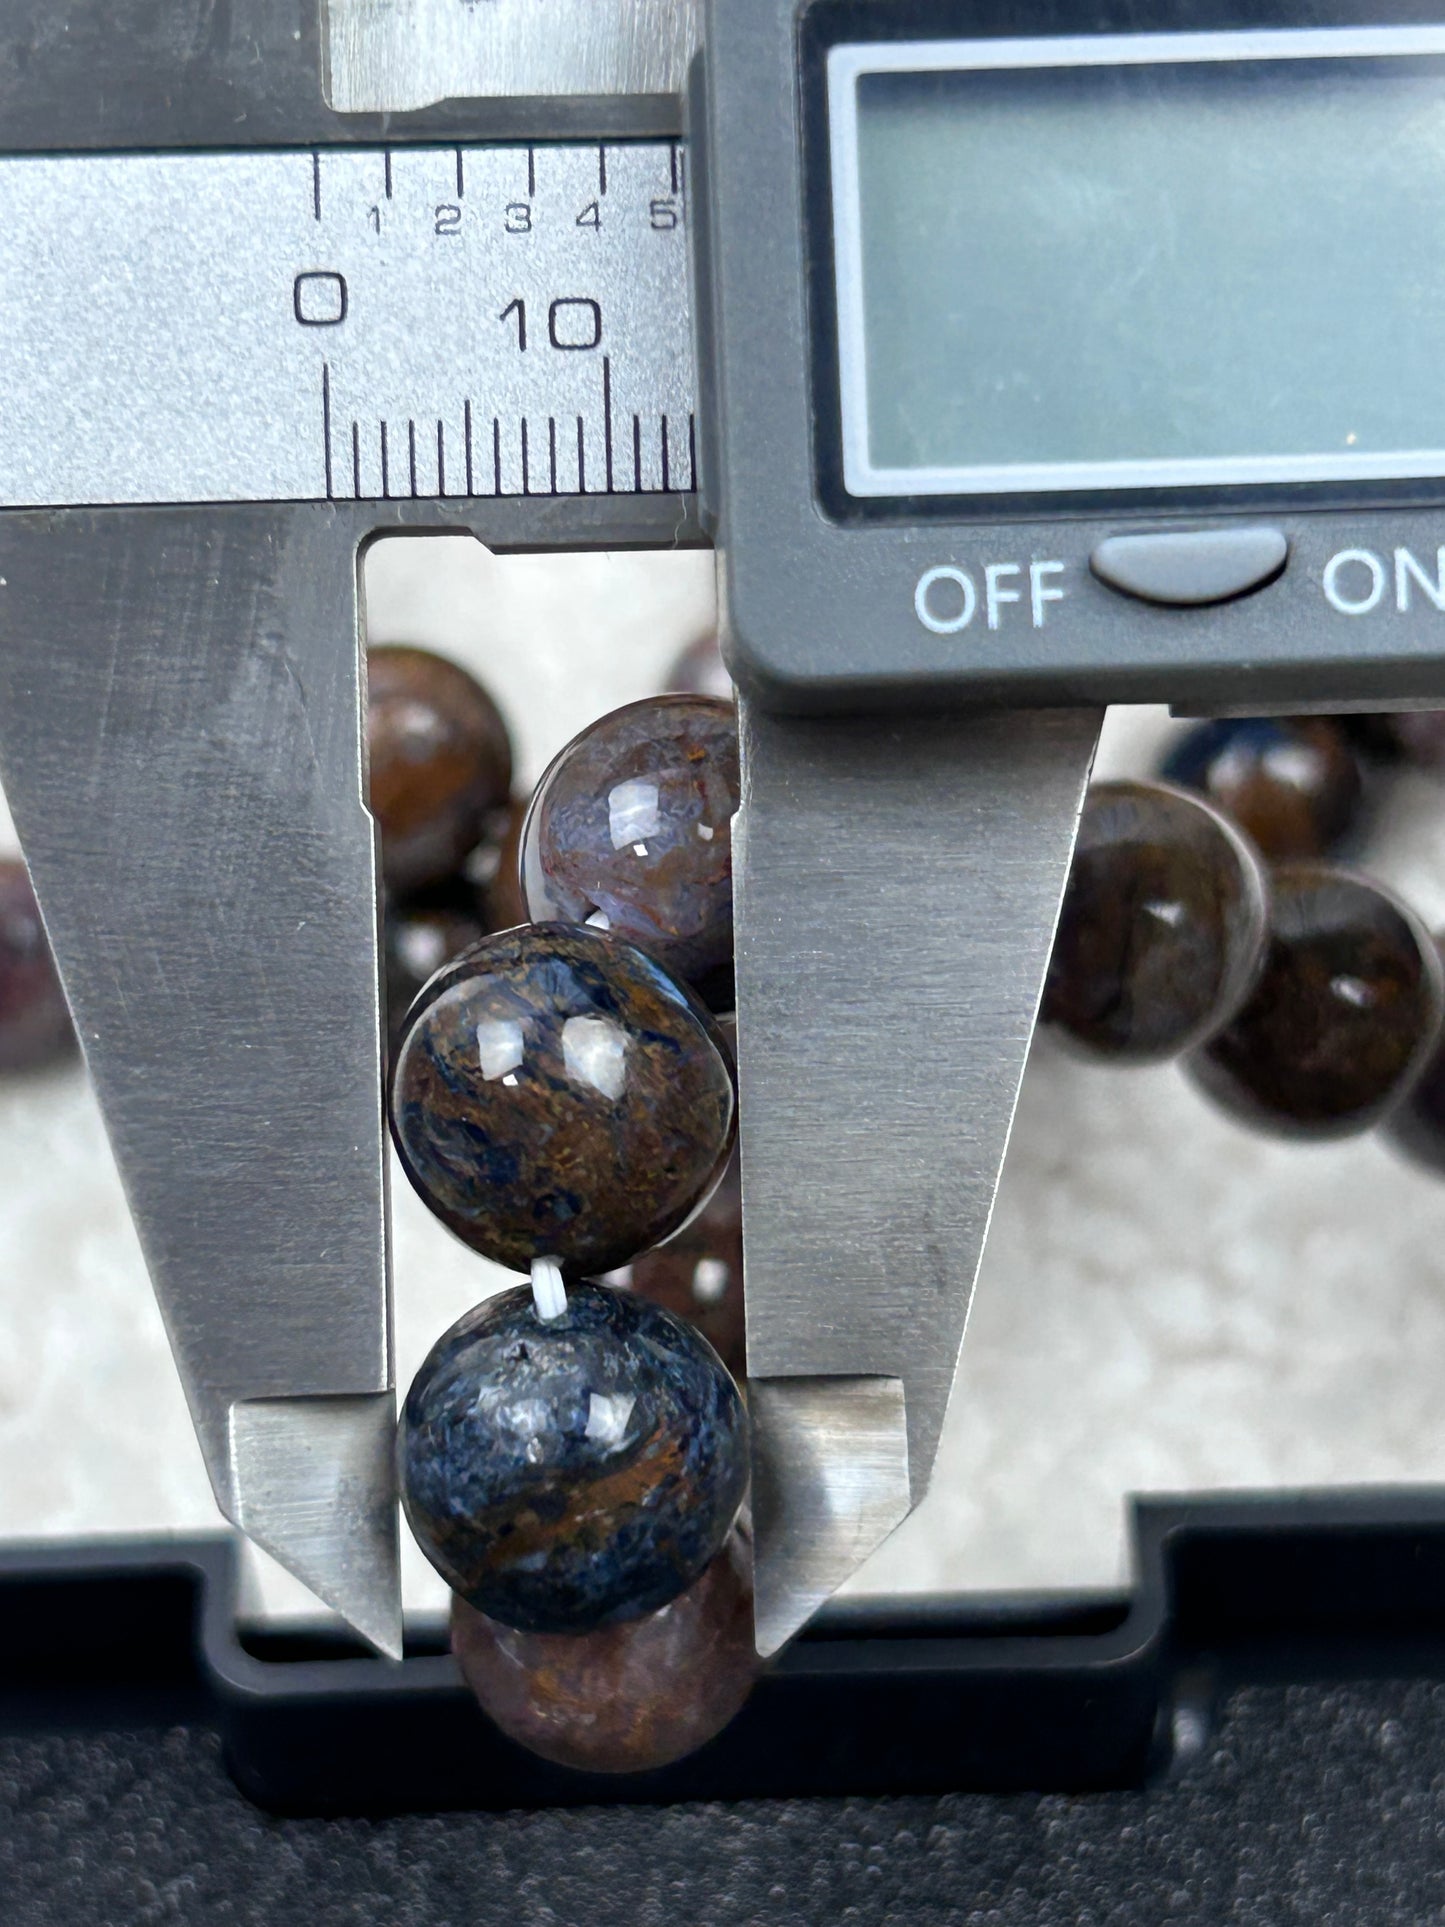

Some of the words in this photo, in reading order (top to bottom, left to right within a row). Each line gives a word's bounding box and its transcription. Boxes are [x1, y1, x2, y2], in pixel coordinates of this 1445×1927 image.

[366, 204, 381, 235] 1
[434, 203, 462, 236] 2
[503, 202, 532, 234] 3
[575, 200, 602, 233] 4
[649, 199, 678, 231] 5
[293, 270, 349, 326] 0
[499, 297, 602, 352] 10
[913, 560, 1066, 634] OFF
[1322, 546, 1445, 616] ON
